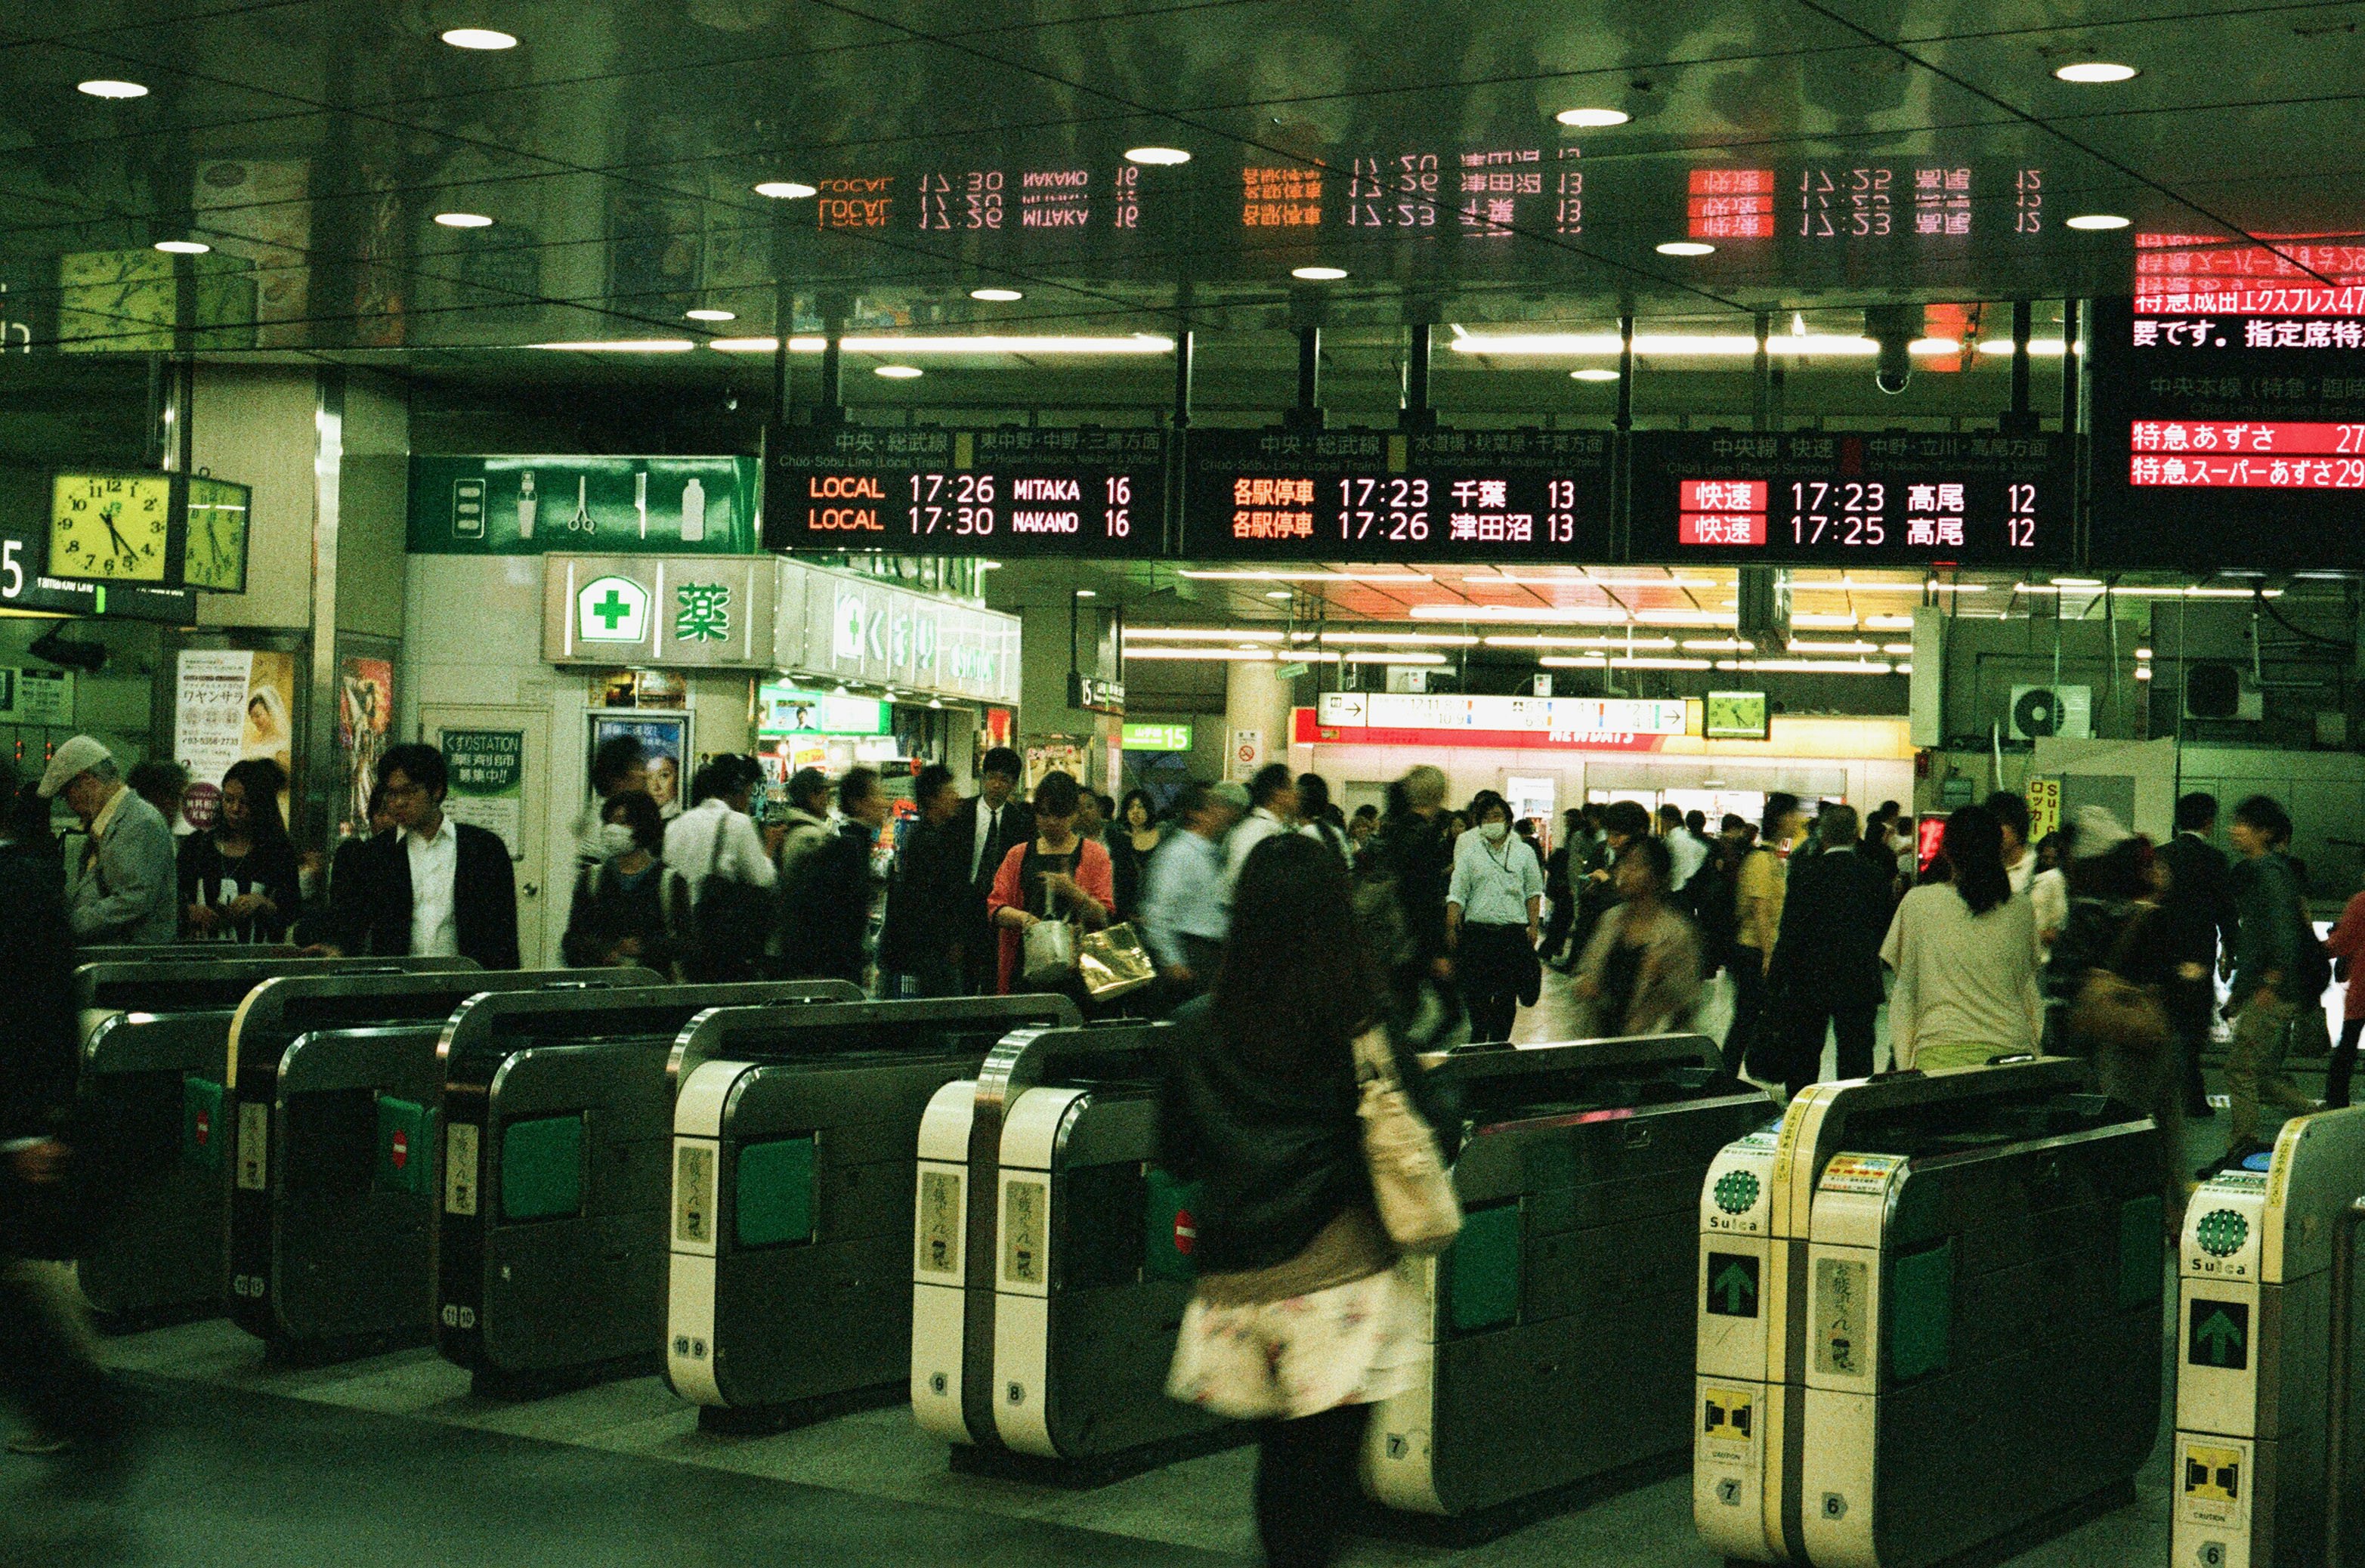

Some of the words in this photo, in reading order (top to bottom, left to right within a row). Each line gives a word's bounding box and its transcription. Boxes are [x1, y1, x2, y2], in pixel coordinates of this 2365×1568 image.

[2134, 320, 2365, 348] 要です。指定席特
[2133, 423, 2276, 451] 特急あずさ
[2336, 424, 2365, 453] 27
[107, 480, 122, 493] 12
[809, 476, 886, 499] LOCAL
[910, 475, 995, 503] 17:26
[1012, 478, 1080, 502] MITAKA
[1105, 476, 1131, 506] 16
[1233, 478, 1315, 507] 各駅停車
[1338, 478, 1430, 508] 17:23
[1450, 480, 1507, 509] 千葉
[1547, 480, 1575, 510] 13
[71, 499, 87, 512] 10
[143, 499, 154, 512] 2
[1694, 481, 1753, 512] 快速
[1791, 481, 1885, 512] 17:23
[1906, 484, 1965, 513] 高尾
[2008, 484, 2036, 515] 12
[62, 518, 73, 530] 9
[150, 521, 161, 533] 3
[808, 508, 884, 530] LOCAL
[909, 506, 994, 536] 17:30
[1012, 511, 1079, 533] NAKANO
[1105, 508, 1130, 537] 16
[1232, 511, 1314, 540] 各駅停車
[1337, 511, 1430, 541] 17:26
[1449, 513, 1533, 543] 津田沼
[1546, 512, 1575, 543] 13
[1693, 515, 1752, 544] 快速
[1790, 515, 1885, 546] 17:25
[1906, 518, 1965, 546] 高尾
[2007, 518, 2036, 548] 12
[69, 540, 80, 552] 8
[1, 540, 23, 598] 5
[85, 554, 96, 567] 7
[104, 558, 114, 571] 6
[675, 582, 730, 642] 薬
[864, 609, 938, 670] くすり
[1164, 727, 1188, 750] 15
[2031, 782, 2044, 835] ロッカー
[1709, 1215, 1758, 1232] Suica
[2191, 1257, 2246, 1276] Suica
[935, 1378, 944, 1392] 9
[1009, 1387, 1019, 1401] 8
[1392, 1438, 1402, 1453] 7
[1726, 1484, 1736, 1501] 7
[1827, 1498, 1839, 1514] 6
[2193, 1511, 2226, 1523] CAUTION
[2206, 1546, 2220, 1564] 6
